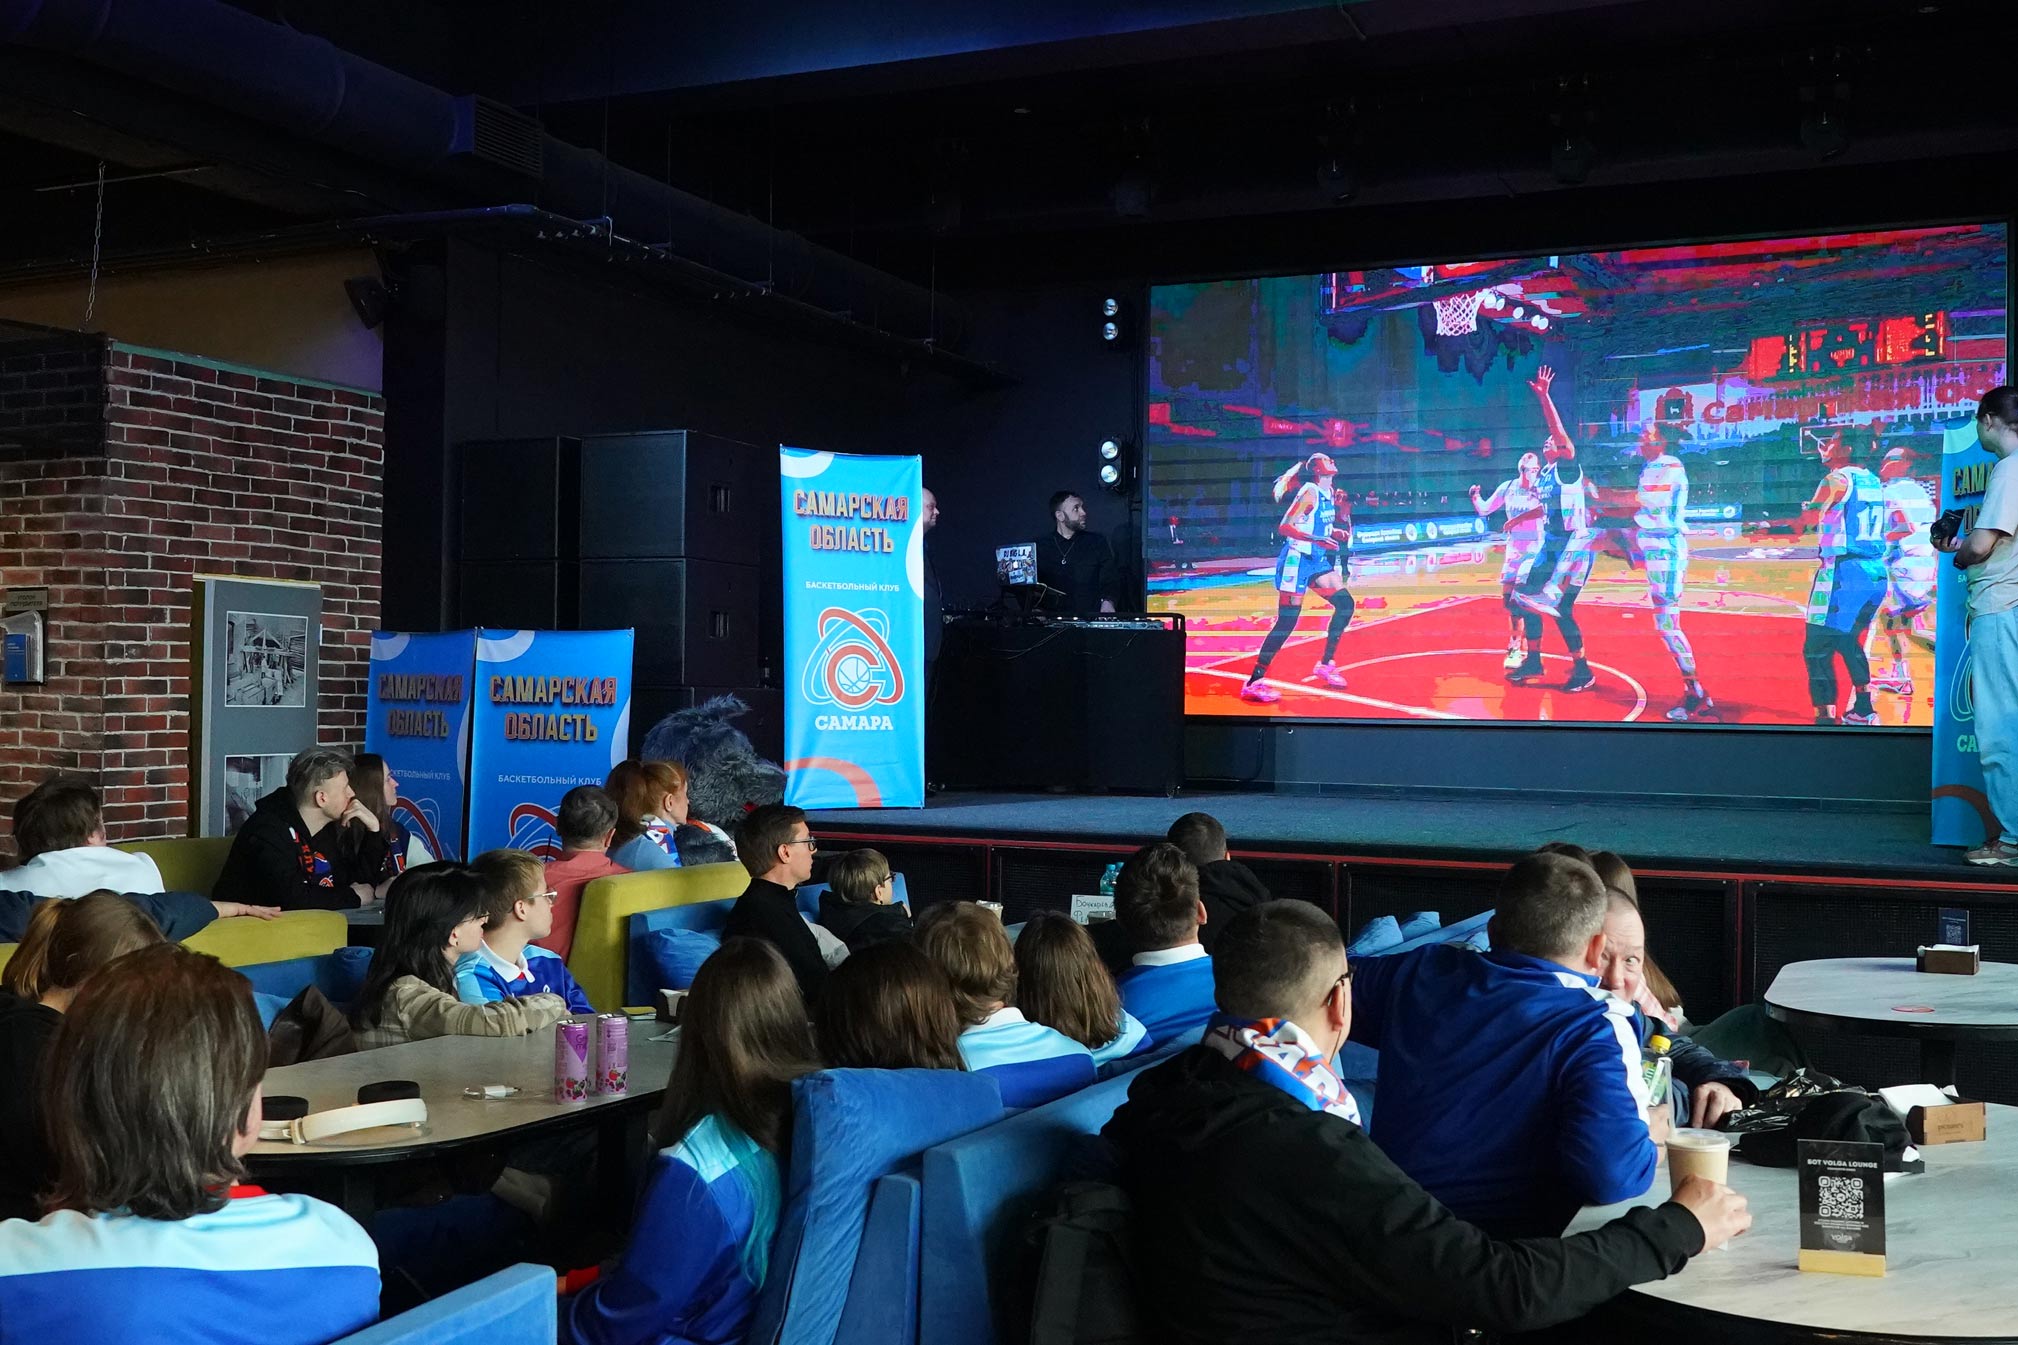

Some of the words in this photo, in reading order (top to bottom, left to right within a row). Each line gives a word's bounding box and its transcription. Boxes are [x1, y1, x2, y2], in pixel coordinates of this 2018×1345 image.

[793, 489, 909, 522] САМАРСКАЯ
[1856, 505, 1884, 541] 17
[810, 524, 895, 553] ОБЛАСТЬ
[805, 581, 877, 591] БАСКЕТБОЛЬНЫЙ
[878, 583, 900, 592] КЛУБ
[379, 673, 464, 703] САМАРСКАЯ
[490, 675, 618, 705] САМАРСКАЯ
[387, 710, 449, 739] ОБЛАСТЬ
[505, 712, 598, 742] ОБЛАСТЬ
[815, 715, 894, 731] САМАРА
[498, 774, 576, 785] БАСКЕТБОЛЬНЫЙ
[578, 777, 602, 786] КЛУБ
